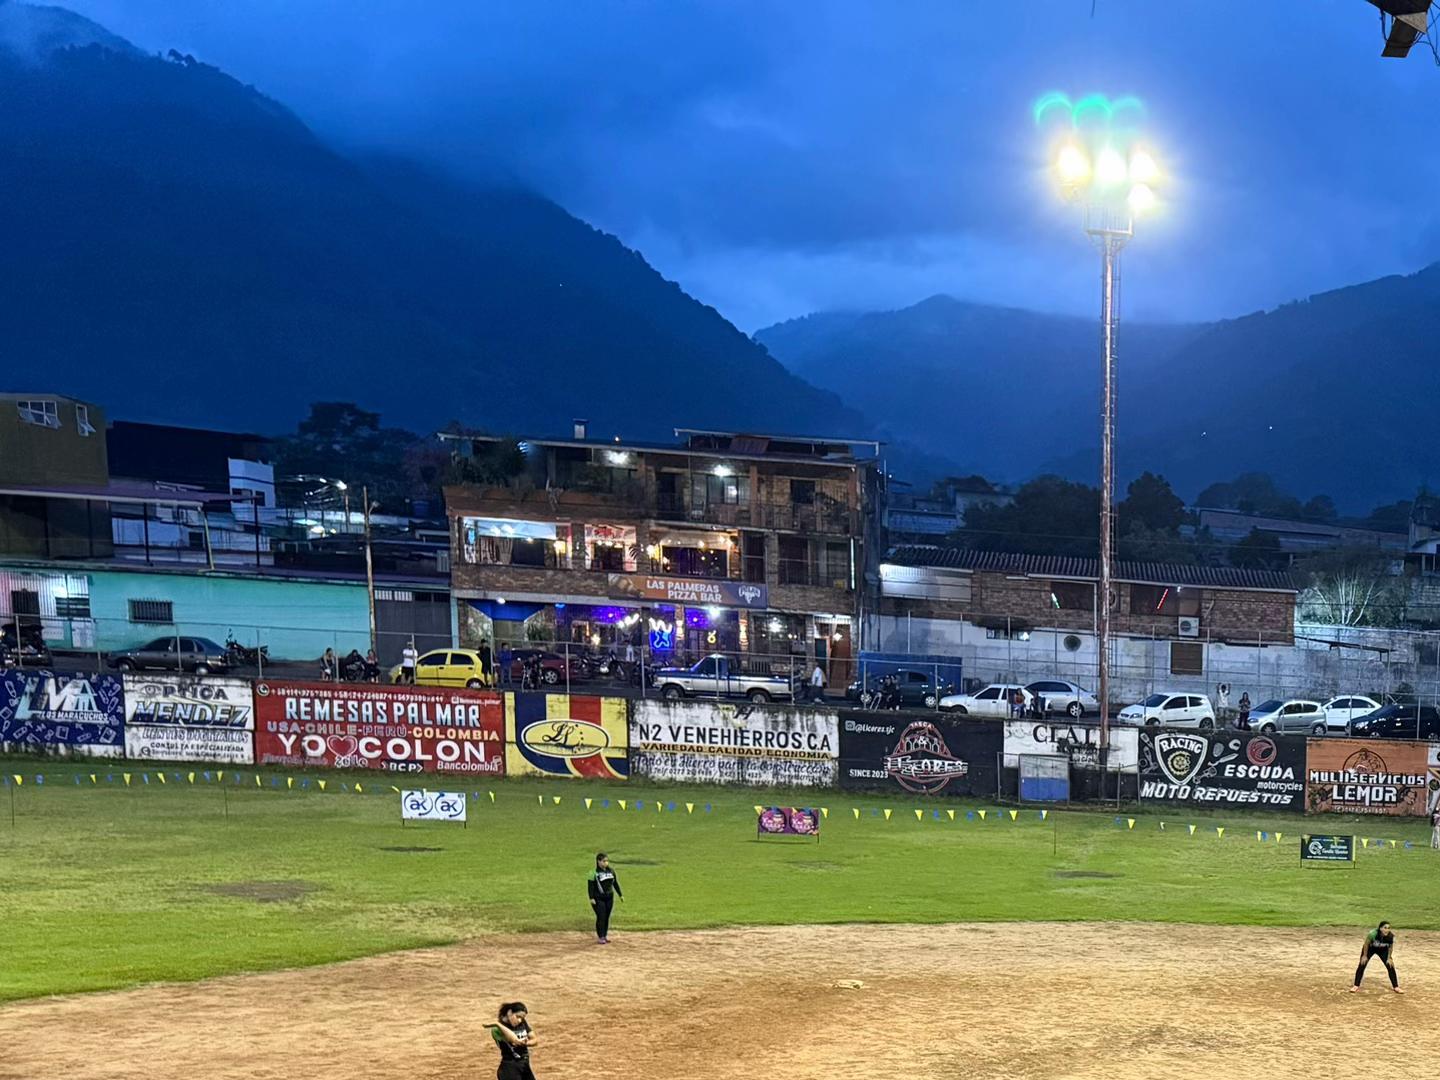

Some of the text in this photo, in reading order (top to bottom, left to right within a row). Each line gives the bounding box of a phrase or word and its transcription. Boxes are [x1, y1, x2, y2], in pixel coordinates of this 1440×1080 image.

[646, 580, 719, 593] LAS PALMERAS
[668, 590, 722, 602] PIZZA BAR
[128, 701, 251, 727] MENDEZ
[285, 697, 480, 727] REMESAS PALMAR
[278, 734, 485, 763] YO COLON
[642, 743, 829, 759] VARIEDAD CALIDAD ECONOMIA
[1160, 738, 1203, 754] RACING
[437, 760, 499, 772] Bancolombia
[849, 769, 889, 779] SINCE 2023
[1224, 764, 1294, 780] ESCUDA
[1141, 781, 1294, 804] MOTO REPUESTOS
[1257, 781, 1303, 793] motorcycles
[1332, 785, 1397, 806] LEMOR
